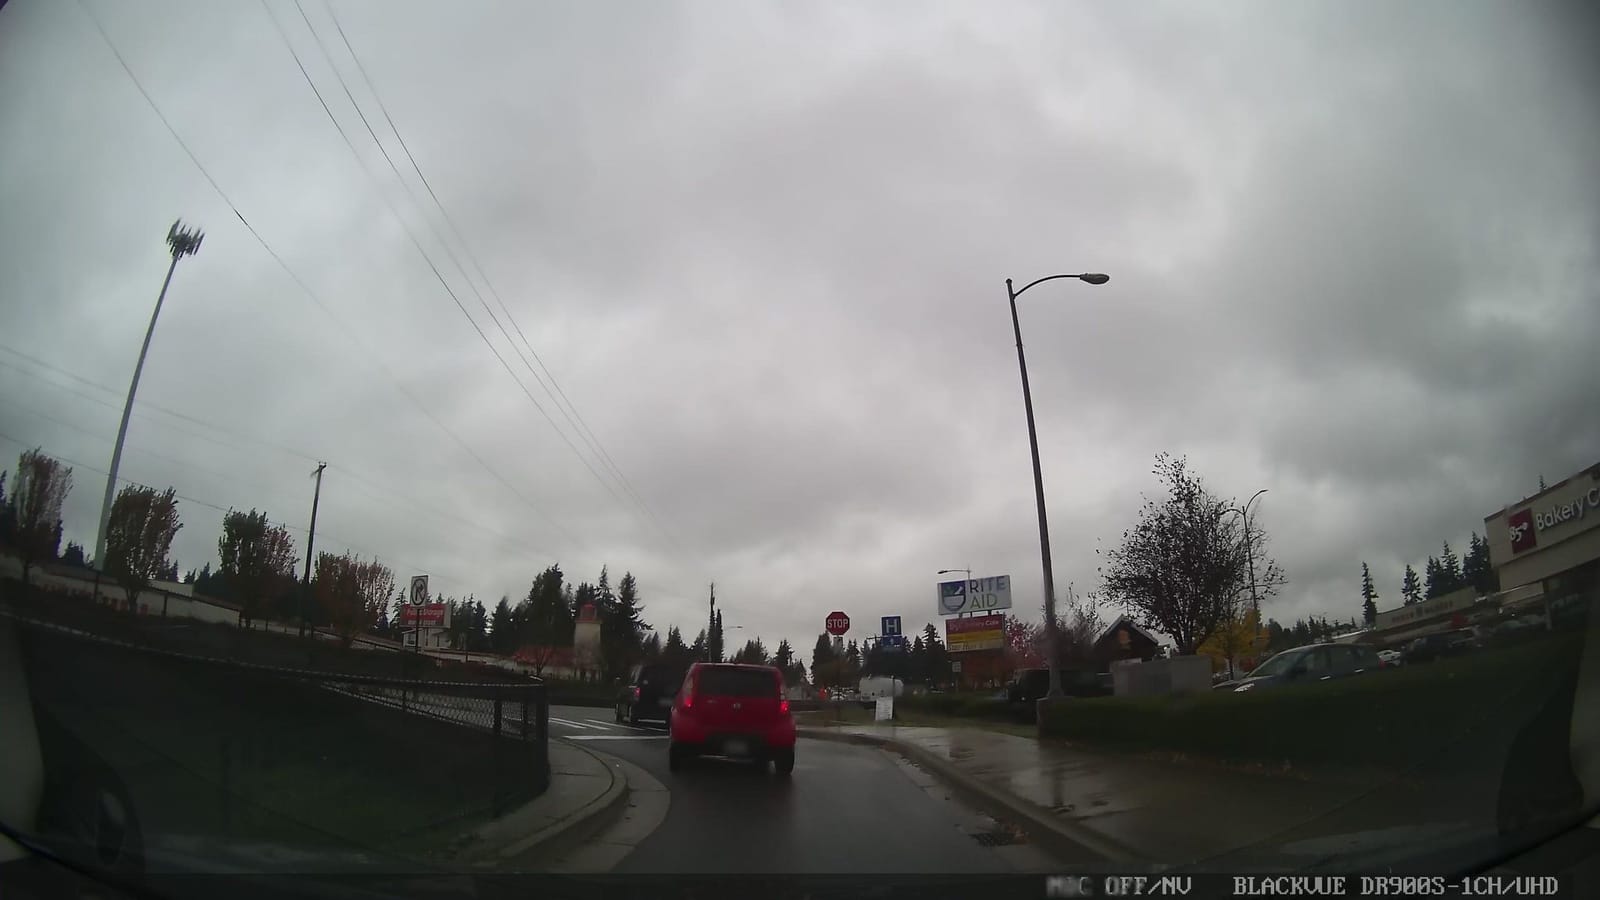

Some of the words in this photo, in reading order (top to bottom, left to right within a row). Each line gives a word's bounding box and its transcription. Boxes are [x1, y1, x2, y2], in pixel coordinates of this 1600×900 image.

[1536, 497, 1583, 530] Bakery
[970, 576, 1006, 593] RITE
[970, 593, 998, 609] AID
[827, 618, 848, 629] STOP
[886, 619, 898, 633] H
